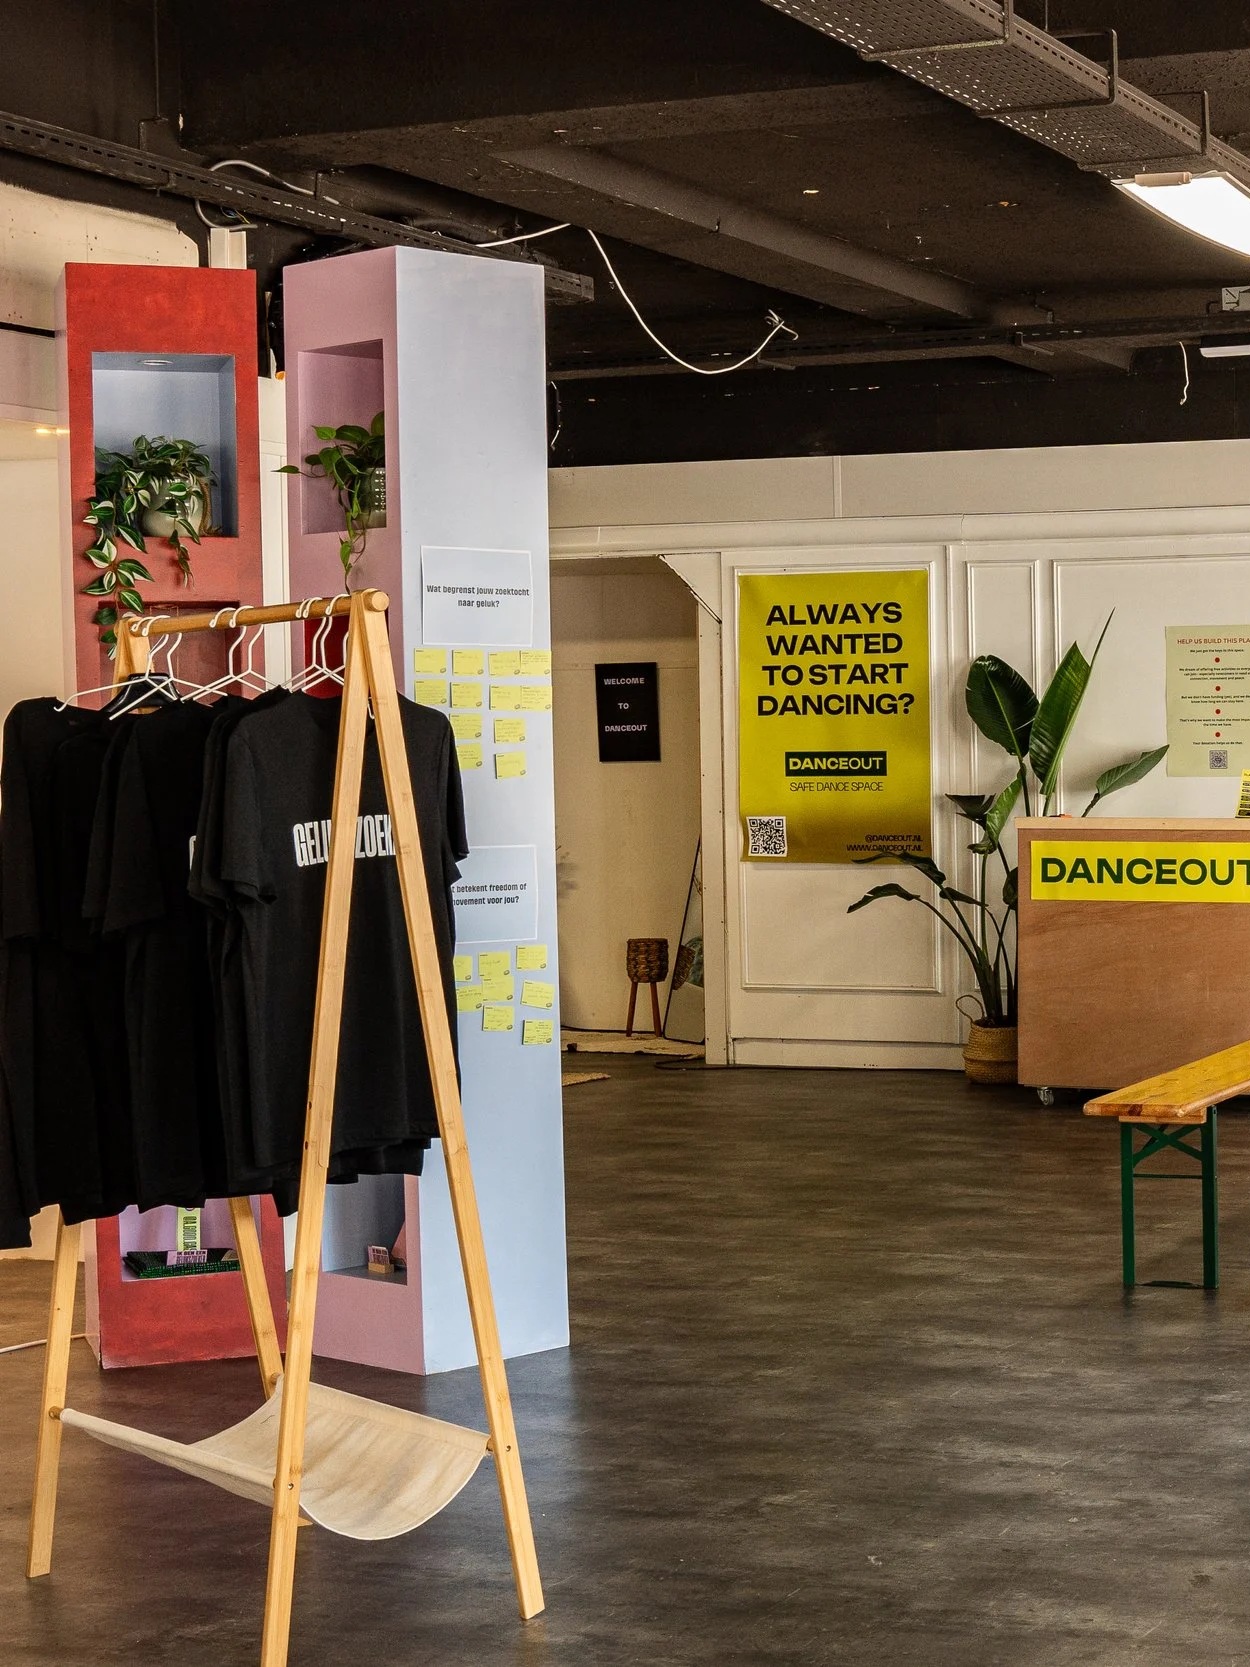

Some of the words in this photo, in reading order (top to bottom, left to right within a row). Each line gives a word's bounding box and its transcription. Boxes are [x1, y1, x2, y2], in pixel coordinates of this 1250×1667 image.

[443, 586, 475, 594] begrenst
[766, 602, 902, 626] ALWAYS
[766, 632, 903, 656] WANTED
[762, 664, 804, 686] TO
[808, 662, 909, 685] START
[757, 693, 915, 716] DANCING?
[789, 756, 883, 771] DANCEOUT
[790, 782, 814, 792] SAFE
[816, 782, 848, 792] DANCE
[851, 781, 884, 792] SPACE
[293, 814, 396, 867] GELUZOEK
[865, 834, 923, 843] @DANCEOUT.NL
[457, 884, 487, 893] betekent
[490, 884, 518, 892] freedom
[504, 896, 519, 905] jou?
